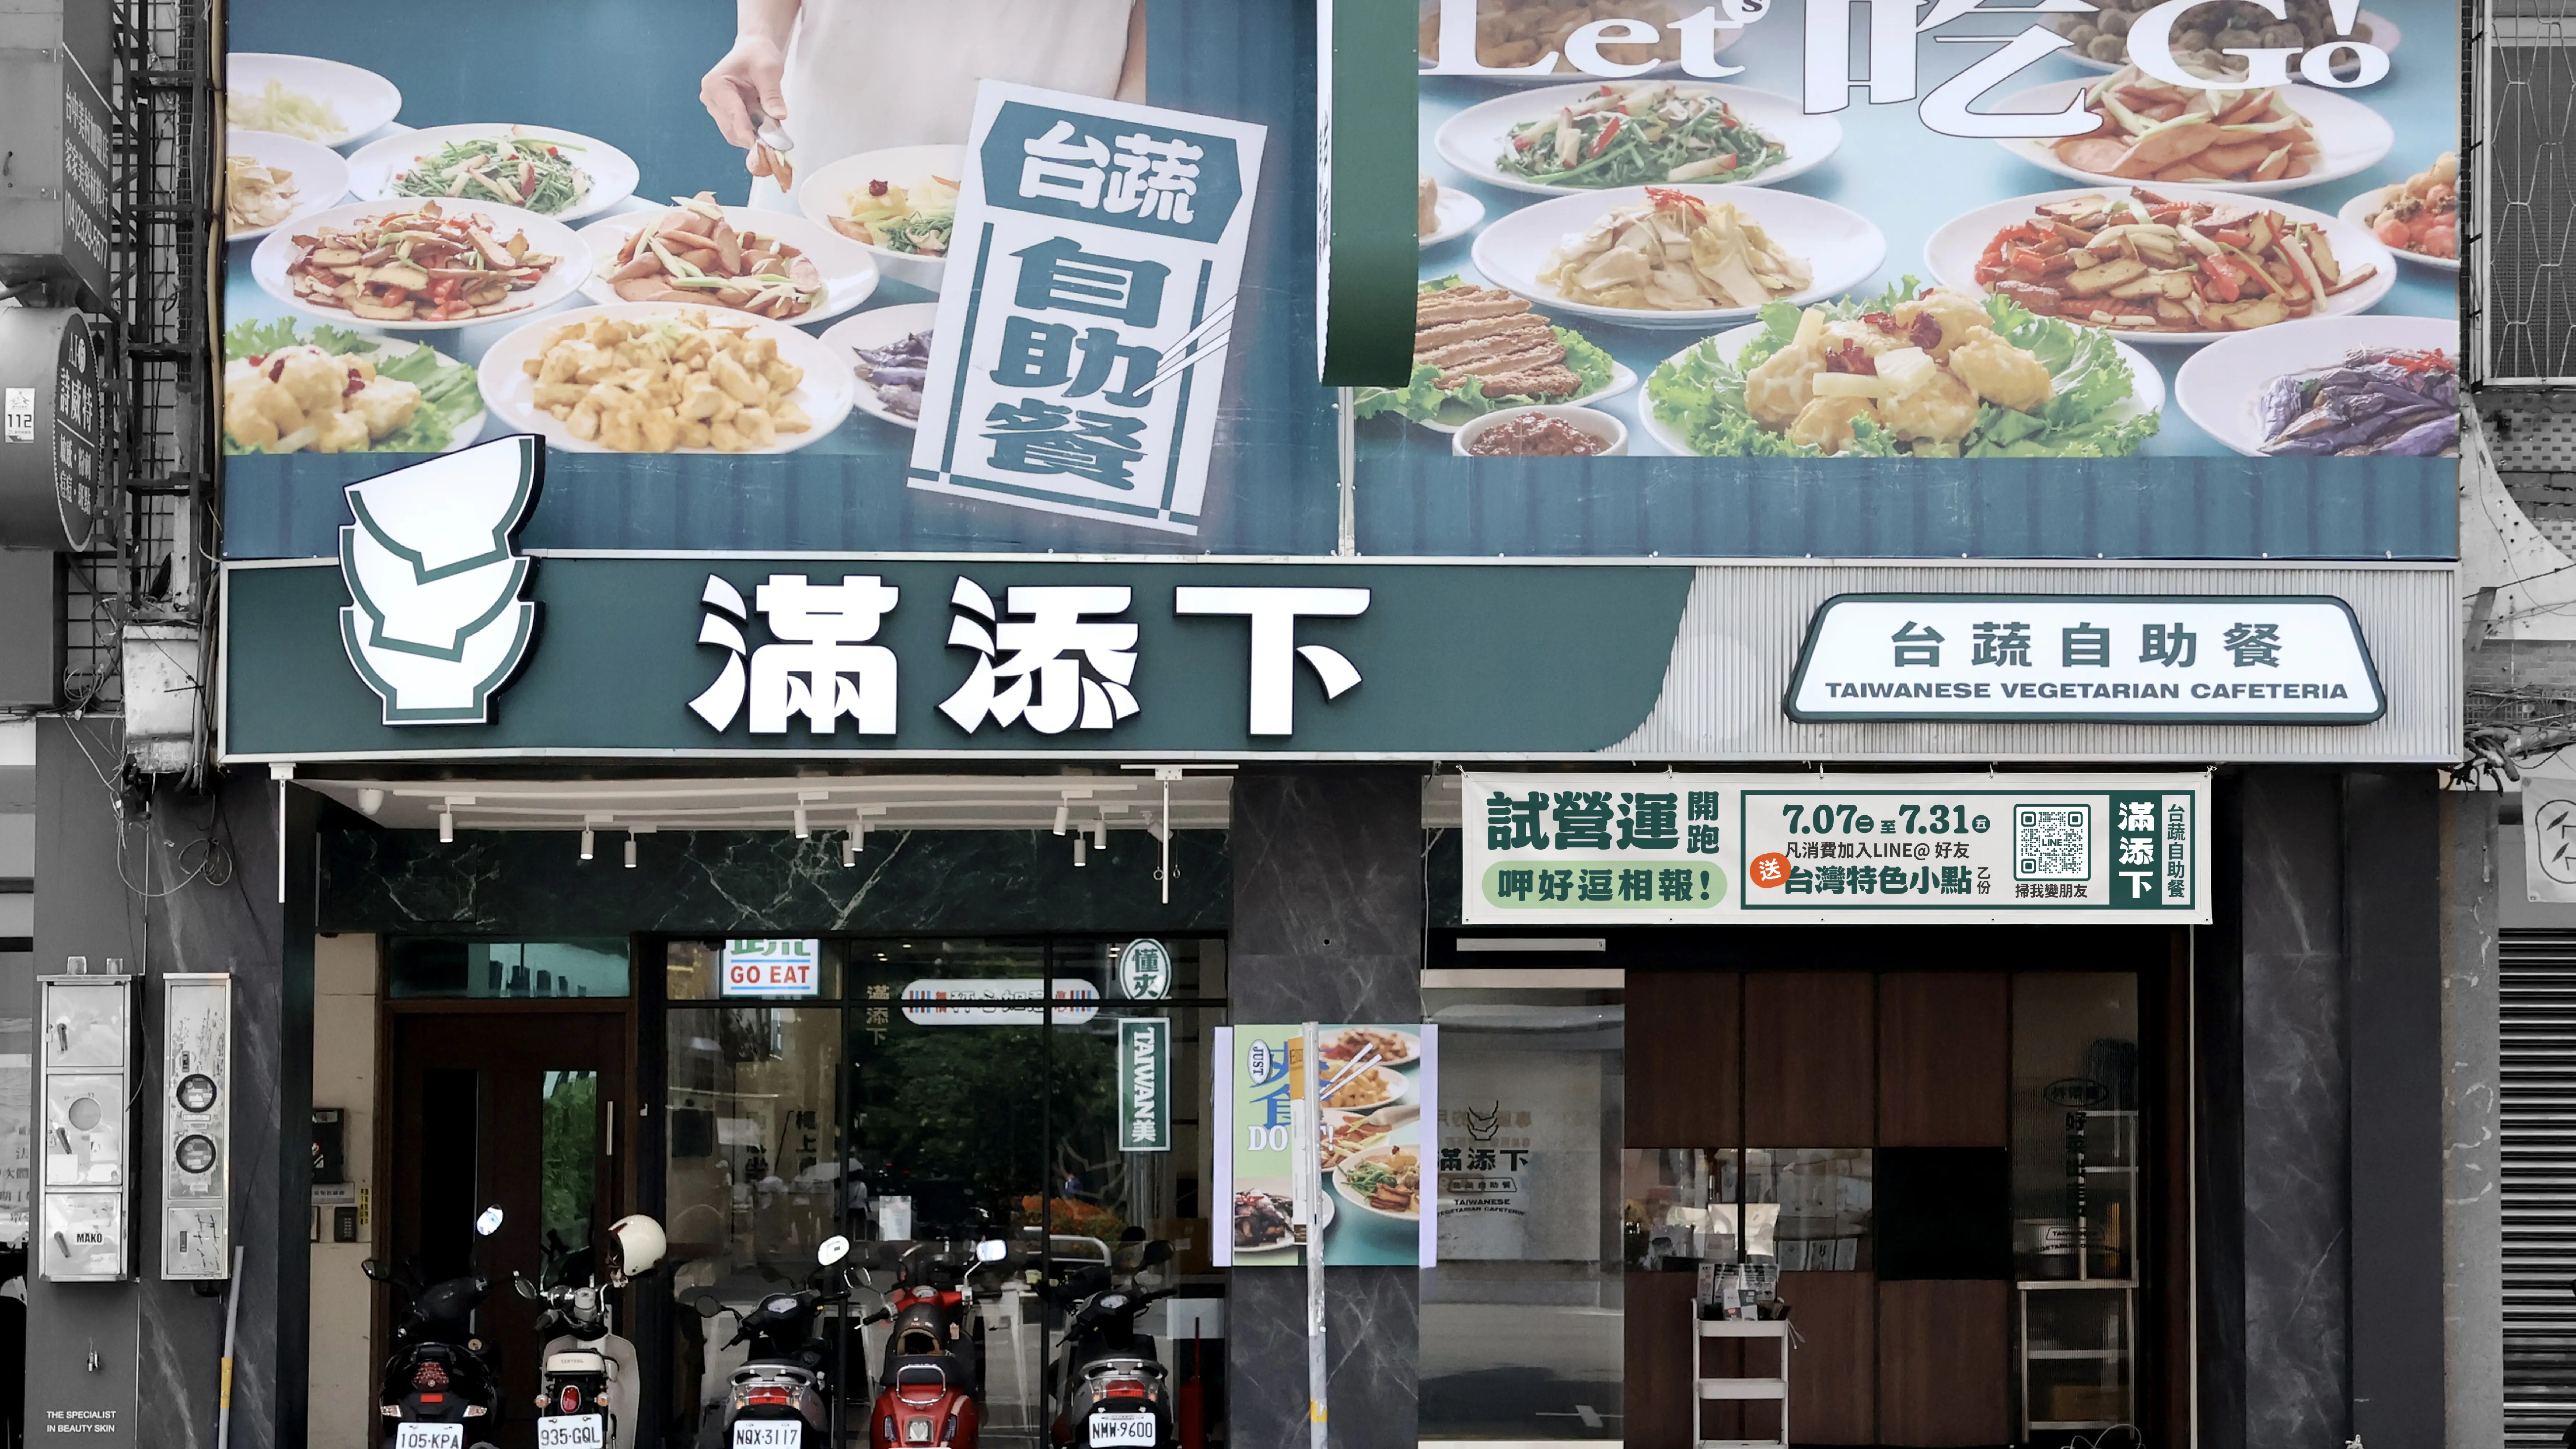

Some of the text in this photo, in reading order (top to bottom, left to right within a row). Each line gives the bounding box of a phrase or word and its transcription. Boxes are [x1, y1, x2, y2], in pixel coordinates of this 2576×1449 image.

[1019, 120, 1205, 224] 台蔬
[979, 236, 1172, 490] 自助餐
[8, 414, 32, 427] 112
[687, 572, 1372, 736] 滿添下
[1891, 621, 2282, 668] 台蔬自助餐
[1825, 682, 2349, 700] TAIWANESE VEGETARIAN CAFETERIA
[1487, 791, 1680, 850] 試營運
[1687, 791, 1719, 853] 開跑
[1880, 820, 1896, 834] 至
[2117, 802, 2154, 898] 滿添下
[2167, 804, 2185, 898] 台蔬自助餐
[1759, 858, 1782, 881] 送
[1785, 865, 1972, 894] 台灣特色小點
[1977, 867, 1991, 894] 乙份
[1498, 869, 1709, 901] 呷好逗相報!
[2015, 884, 2087, 898] 掃我變朋友
[731, 965, 810, 983] GO EAT
[866, 985, 889, 1045] 滿添下
[1253, 1046, 1264, 1076] JUST
[1248, 1125, 1289, 1151] DO
[1439, 1147, 1528, 1172] 滿添下
[76, 1233, 103, 1243] MAKO
